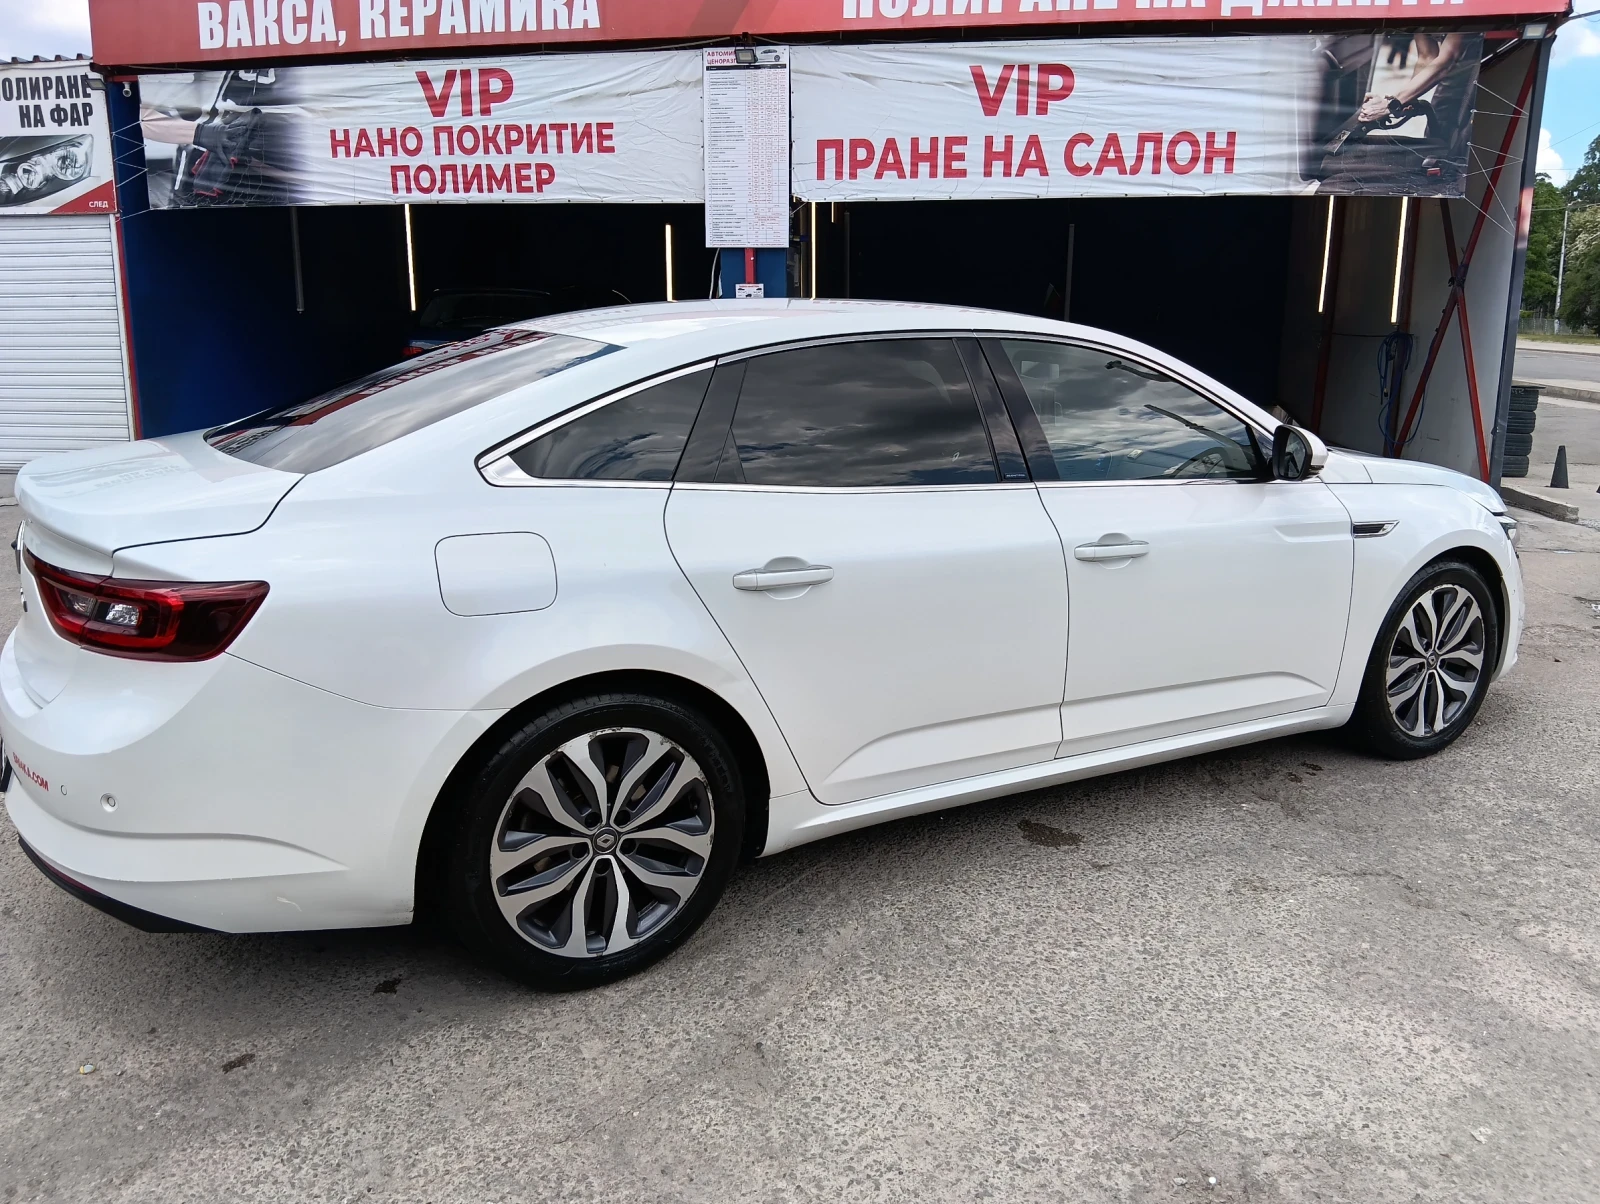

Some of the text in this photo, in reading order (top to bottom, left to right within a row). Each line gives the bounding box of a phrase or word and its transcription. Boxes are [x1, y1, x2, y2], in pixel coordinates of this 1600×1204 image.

[197, 0, 601, 50] ВАКСА, КЕРАМИКА
[0, 74, 92, 102] ОЛИРАНЕ
[415, 68, 514, 118] VIP
[969, 63, 1075, 117] VIP
[18, 102, 94, 129] НА ФАР
[330, 122, 615, 159] НАНО ПОКРИТИЕ
[816, 131, 1237, 181] ПРАНЕ НА САЛОН
[390, 162, 556, 195] ПОЛИМЕР
[88, 200, 109, 208] СЛЕД
